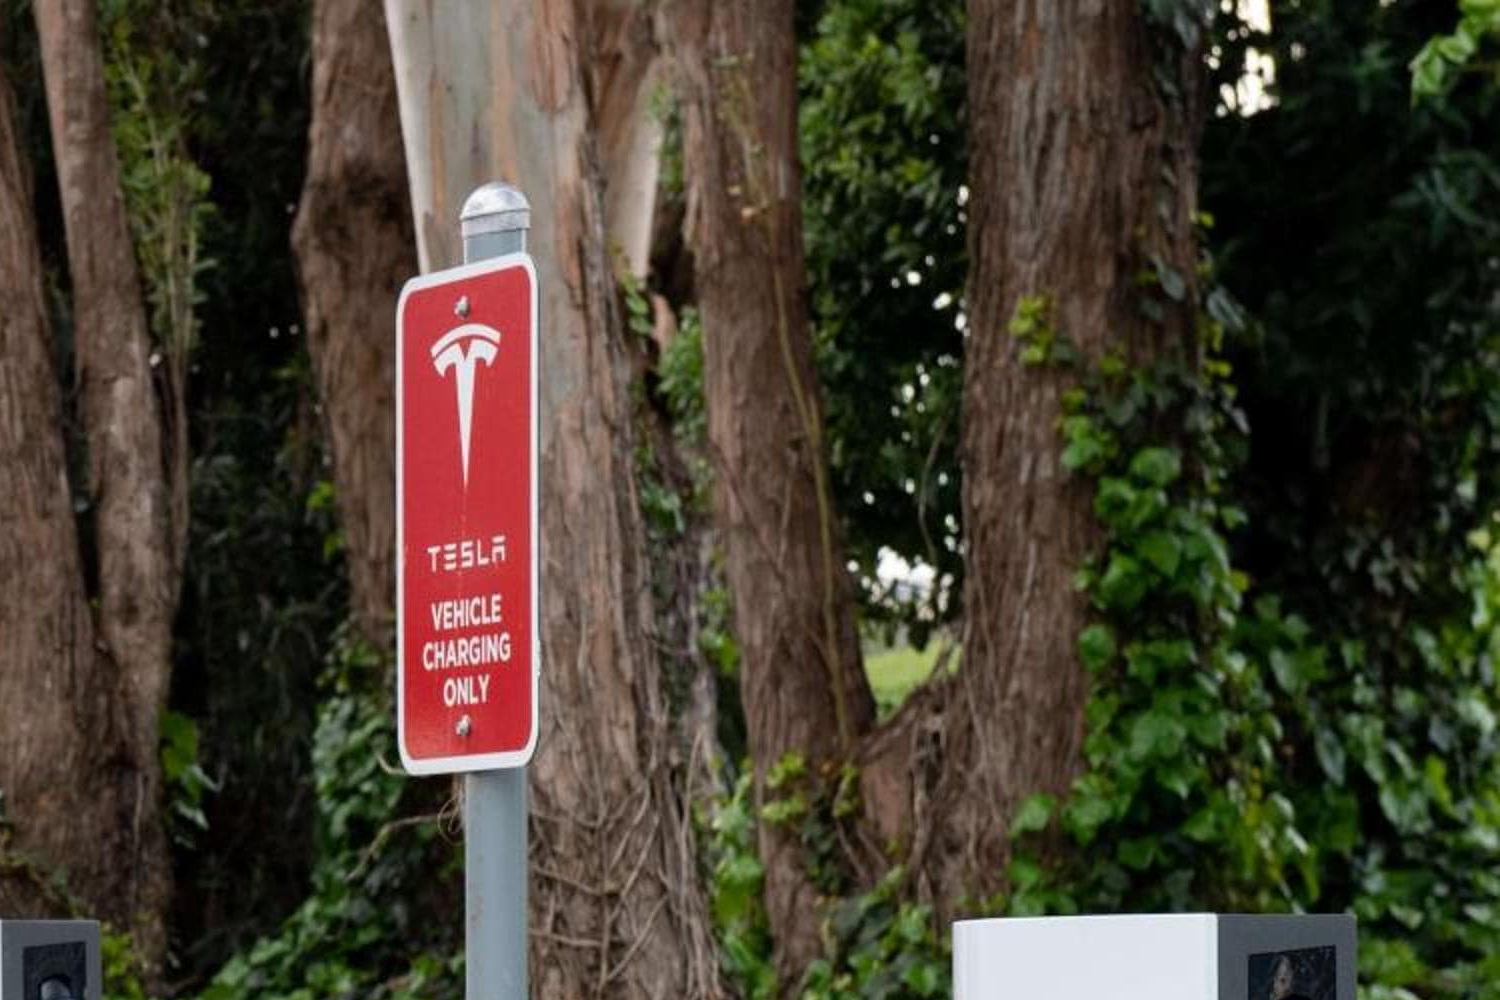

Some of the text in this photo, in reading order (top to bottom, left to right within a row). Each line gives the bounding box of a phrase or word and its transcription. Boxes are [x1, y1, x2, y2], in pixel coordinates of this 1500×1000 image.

[427, 536, 505, 572] TESLA
[432, 595, 501, 630] VEHICLE
[423, 633, 511, 671] CHARGING
[443, 674, 490, 707] ONLY
